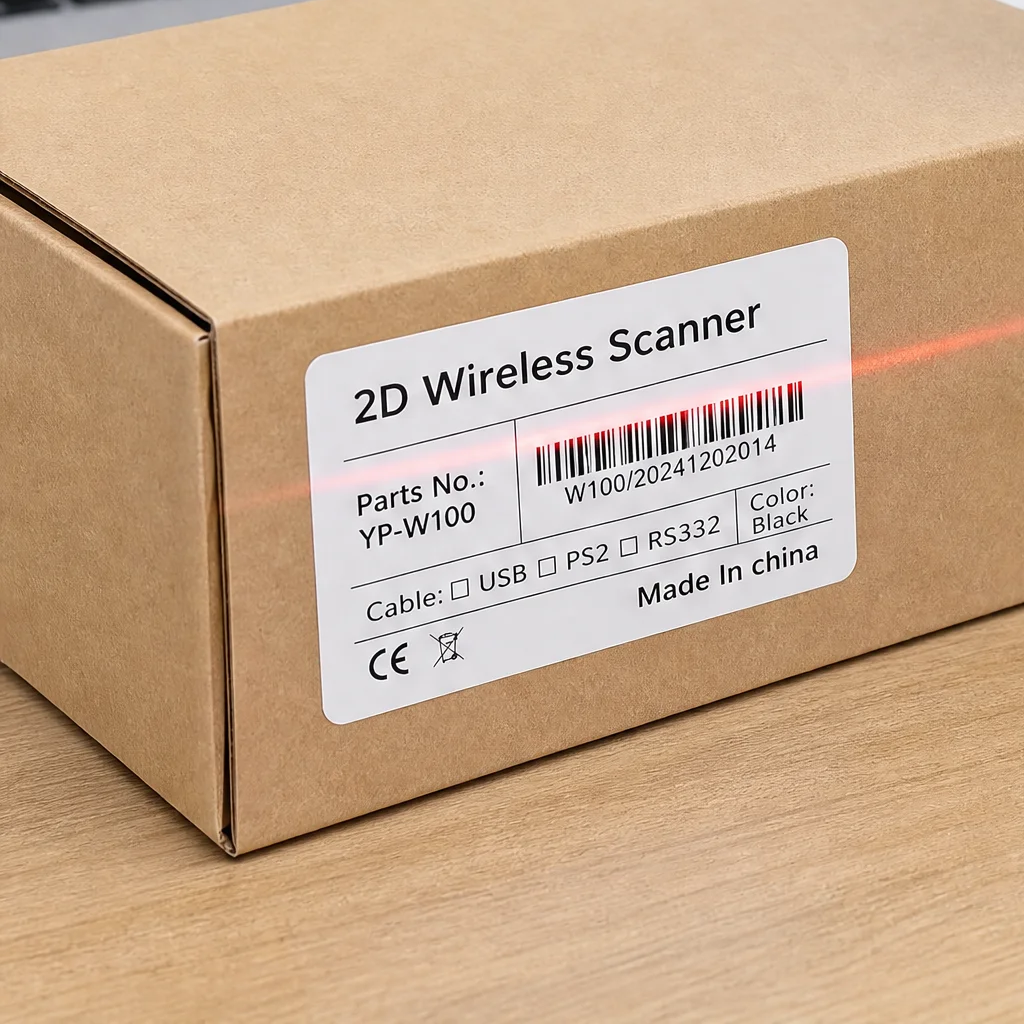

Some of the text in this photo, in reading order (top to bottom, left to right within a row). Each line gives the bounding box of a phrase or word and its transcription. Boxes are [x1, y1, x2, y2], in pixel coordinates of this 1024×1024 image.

[354, 303, 761, 424] 2D Wireless Scanner
[565, 434, 777, 504] W100/20241202014
[357, 471, 485, 516] Parts No.:
[750, 484, 815, 512] Color:
[359, 502, 476, 549] YP-W100
[752, 506, 809, 535] Black
[366, 516, 721, 622] Cable: USB PS2 RS332
[638, 544, 819, 607] Made In china
[369, 642, 409, 680] CE
